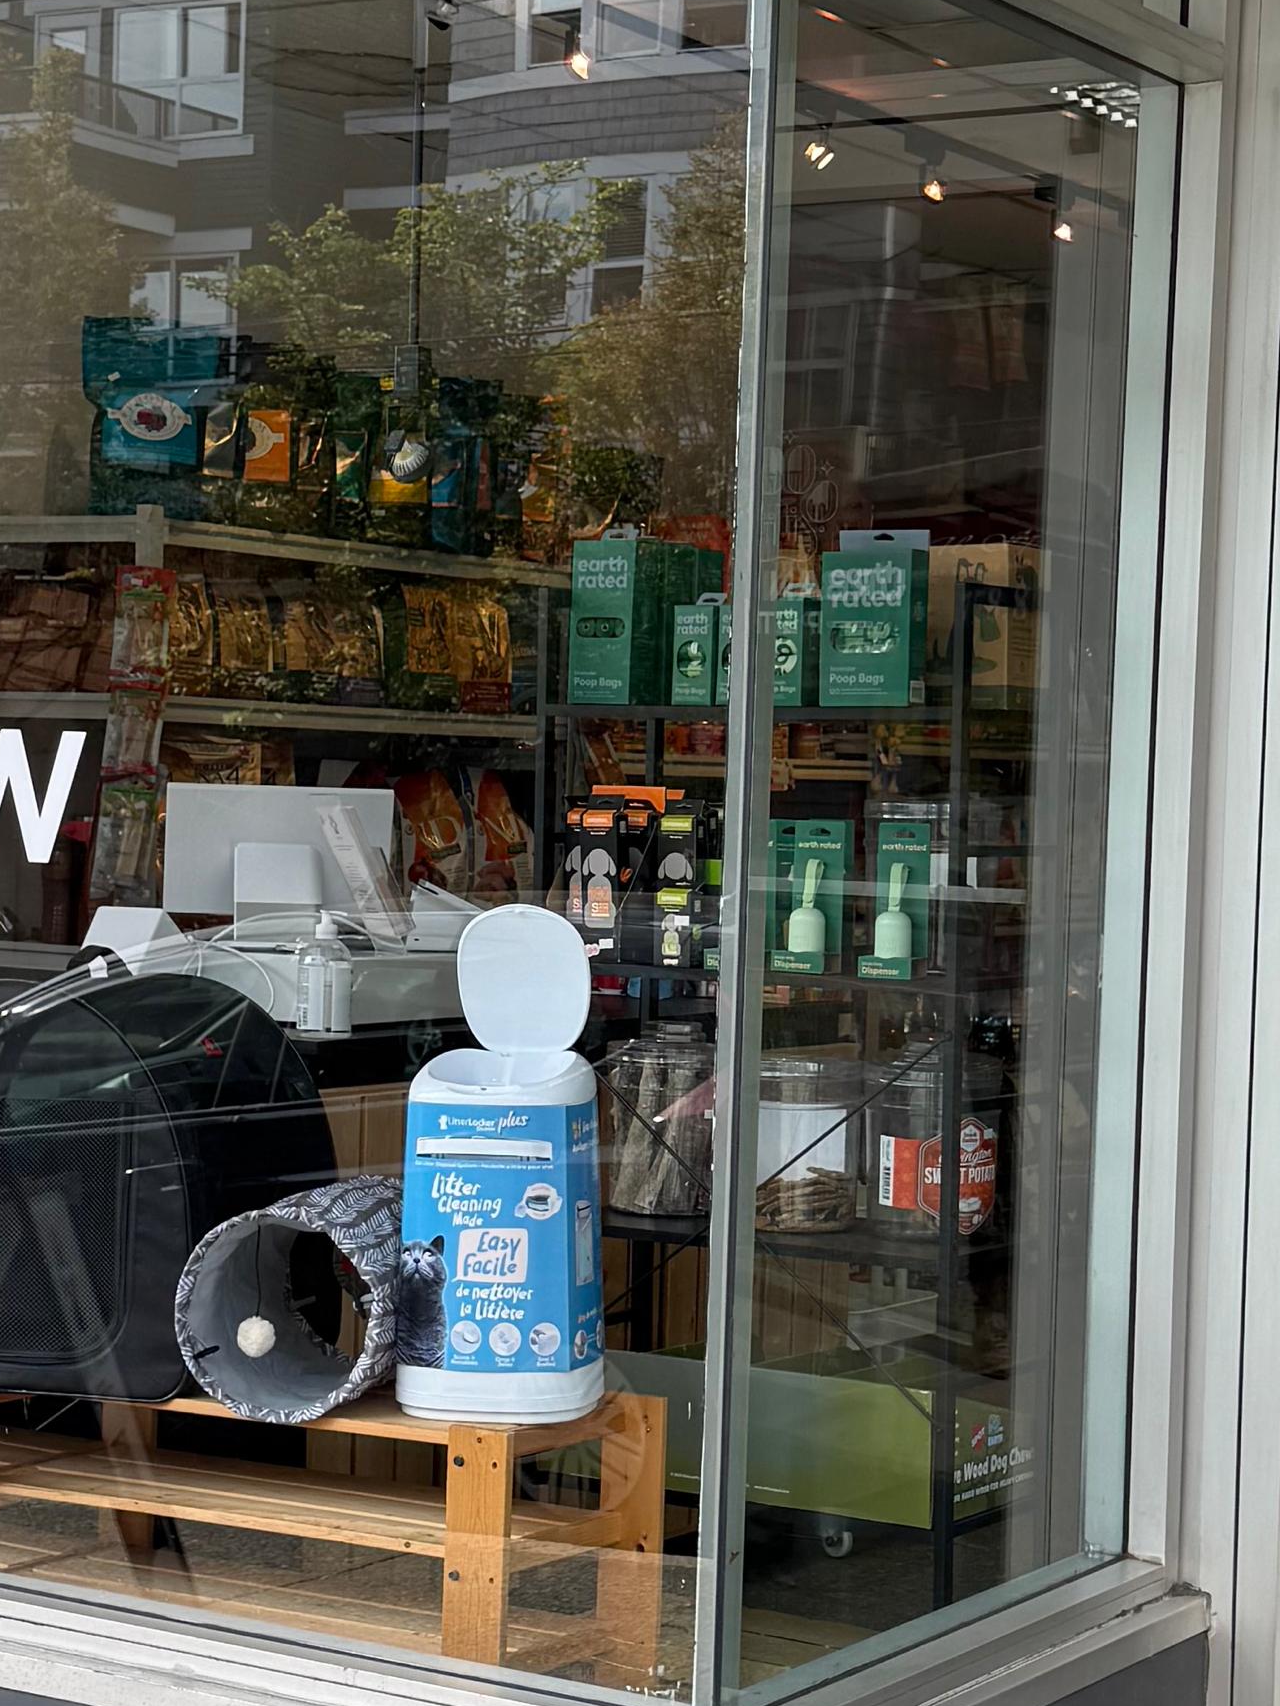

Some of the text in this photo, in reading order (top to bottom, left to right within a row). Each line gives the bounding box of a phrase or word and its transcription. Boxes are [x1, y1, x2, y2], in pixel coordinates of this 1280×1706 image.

[577, 556, 628, 572] earth
[830, 560, 906, 585] earth
[577, 573, 628, 589] rated
[830, 585, 906, 608] rated
[676, 613, 709, 625] earth
[676, 624, 709, 635] rated
[574, 676, 622, 689] Poop Bags
[830, 673, 884, 685] Poop Bags
[798, 841, 841, 850] earth rated
[882, 843, 928, 852] earth rated
[498, 1110, 530, 1134] plus
[924, 1167, 968, 1184] SWT
[431, 1172, 481, 1198] Litter
[438, 1196, 502, 1218] Cleaning
[452, 1213, 483, 1228] Made
[476, 1231, 521, 1261] Easy
[456, 1283, 534, 1301] de nettoyer
[460, 1301, 472, 1317] la
[963, 1456, 989, 1481] Wood
[990, 1454, 1008, 1474] Dog
